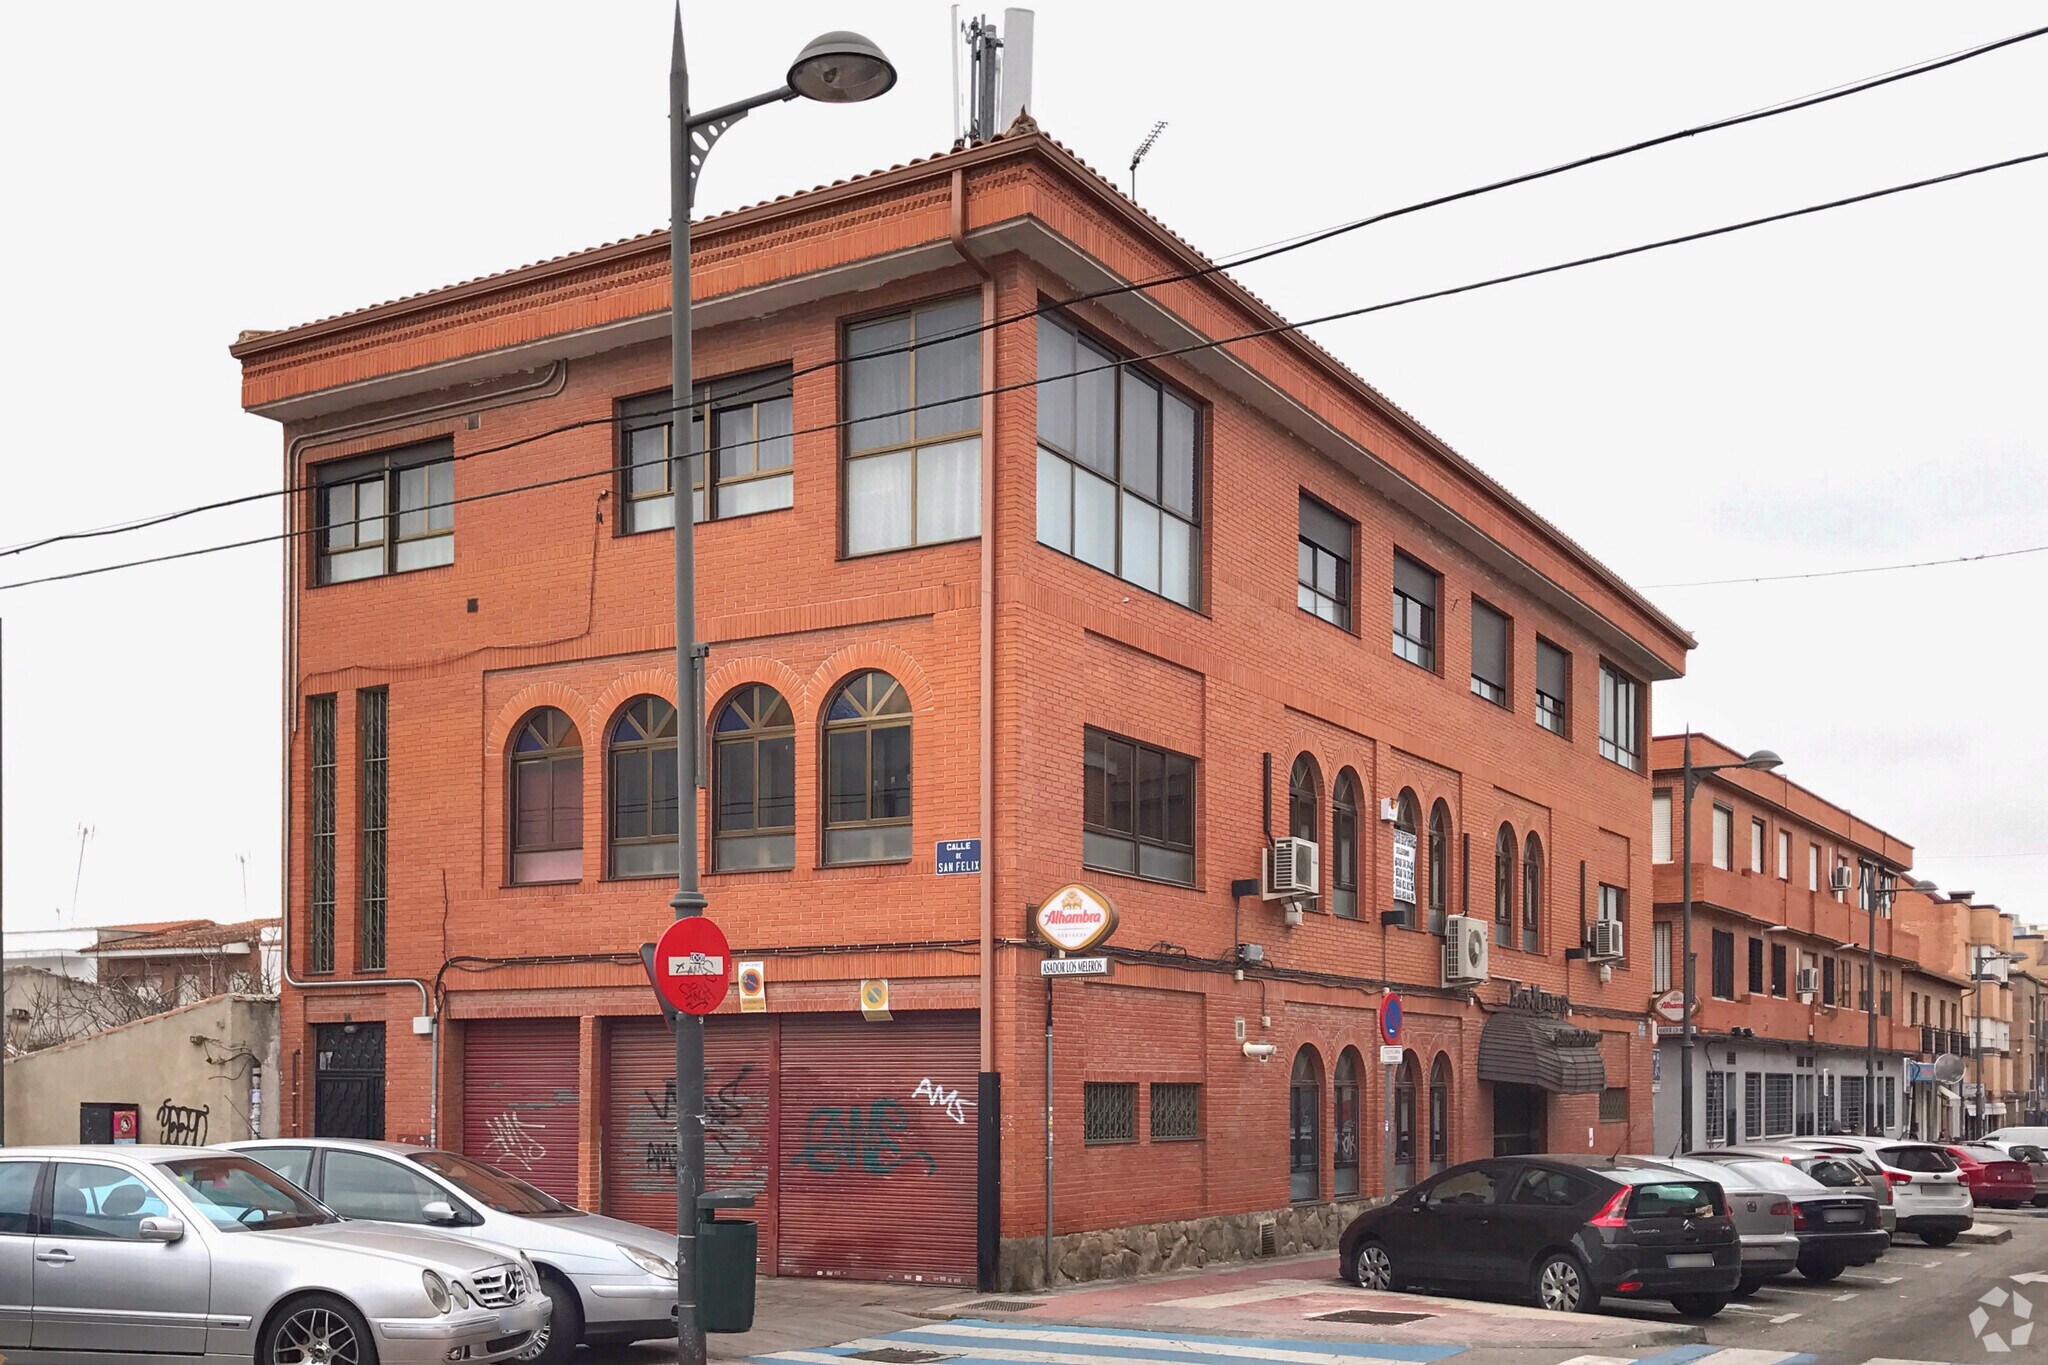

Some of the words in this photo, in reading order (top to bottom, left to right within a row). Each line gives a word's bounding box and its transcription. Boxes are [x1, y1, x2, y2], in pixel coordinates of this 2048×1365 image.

[946, 841, 971, 851] CALLE
[955, 852, 962, 860] DE
[938, 862, 954, 873] SAN
[955, 860, 980, 872] FELIX
[1044, 909, 1102, 926] Alhambra
[1043, 961, 1066, 974] ASADOR
[1066, 961, 1077, 973] LOS
[1077, 960, 1103, 973] MELEROS
